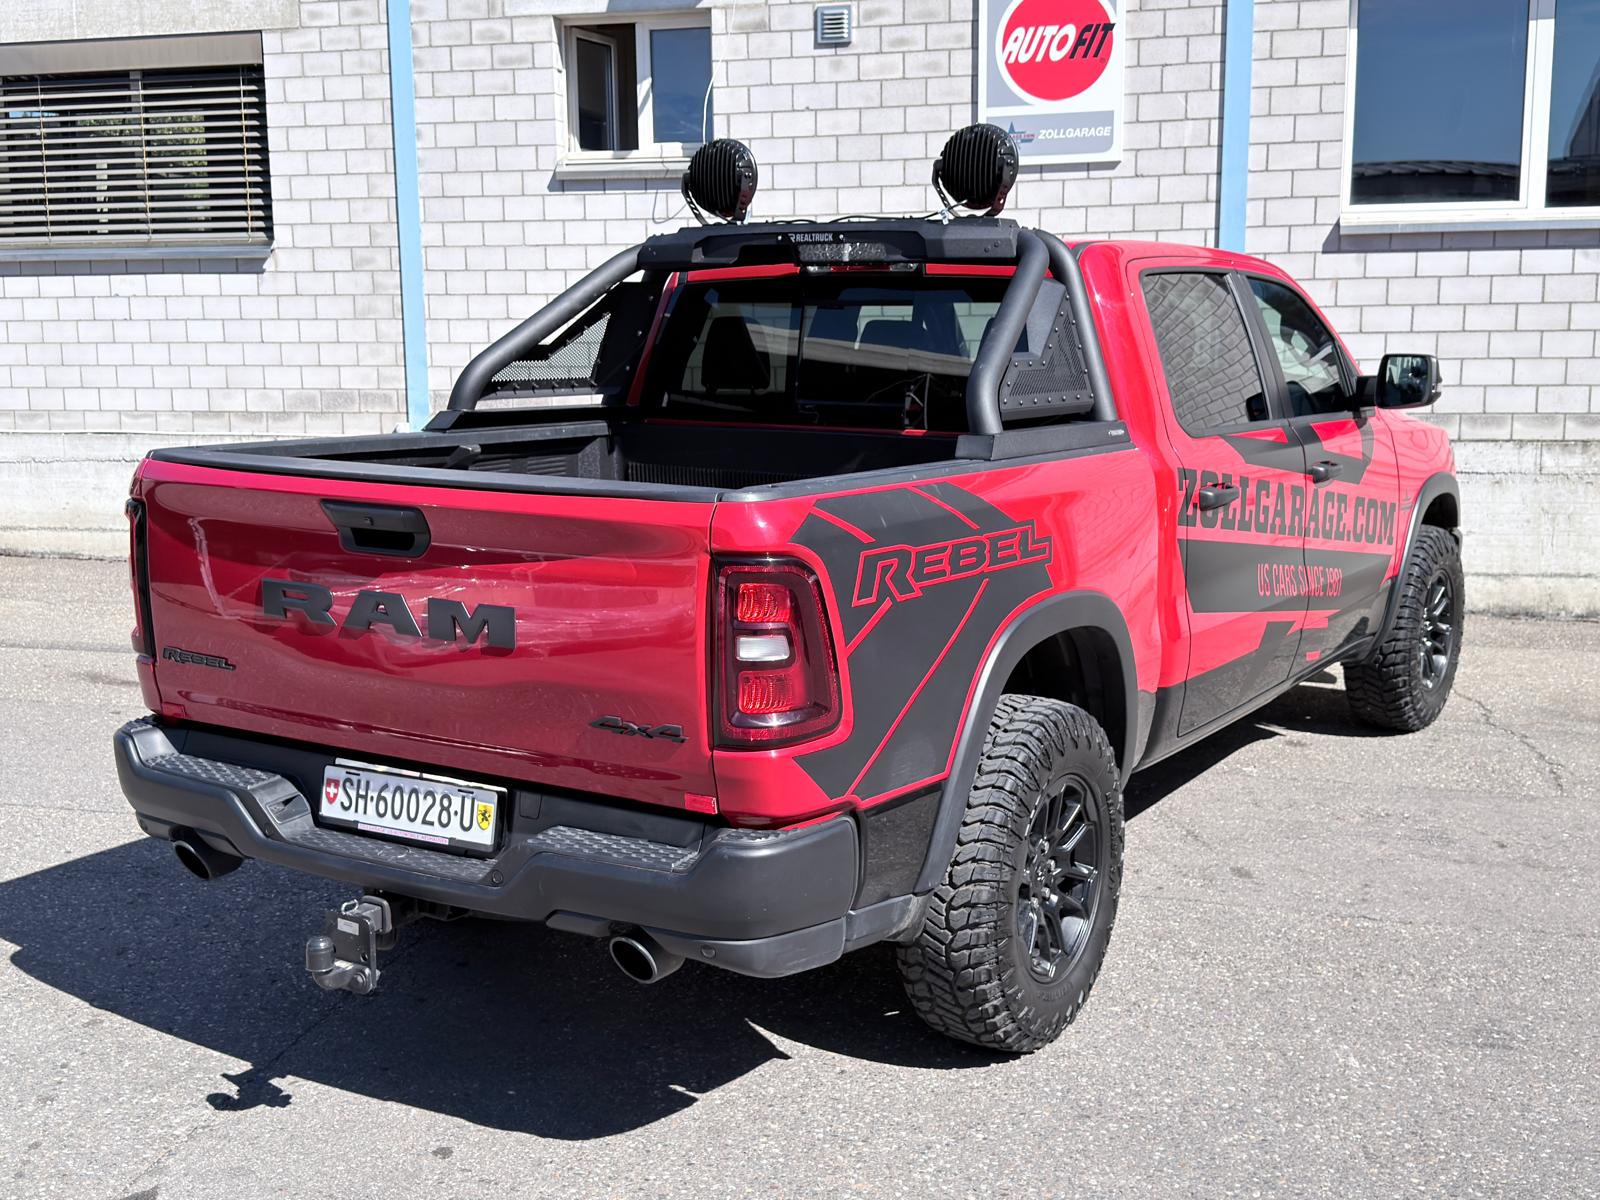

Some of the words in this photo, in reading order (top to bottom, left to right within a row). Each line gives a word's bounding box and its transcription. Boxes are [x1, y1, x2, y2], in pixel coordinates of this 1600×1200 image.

[1002, 23, 1116, 64] AUTOFIT
[1038, 126, 1112, 139] ZOLLGARAGE
[795, 233, 834, 242] REALTRUCK
[1177, 467, 1396, 546] ZOLLGARAGE.COM
[852, 525, 1050, 608] REBEL
[1257, 562, 1271, 597] US
[1272, 563, 1298, 598] CARS
[1298, 564, 1325, 598] SINCE
[261, 578, 517, 651] RAM
[163, 646, 236, 671] REBEL
